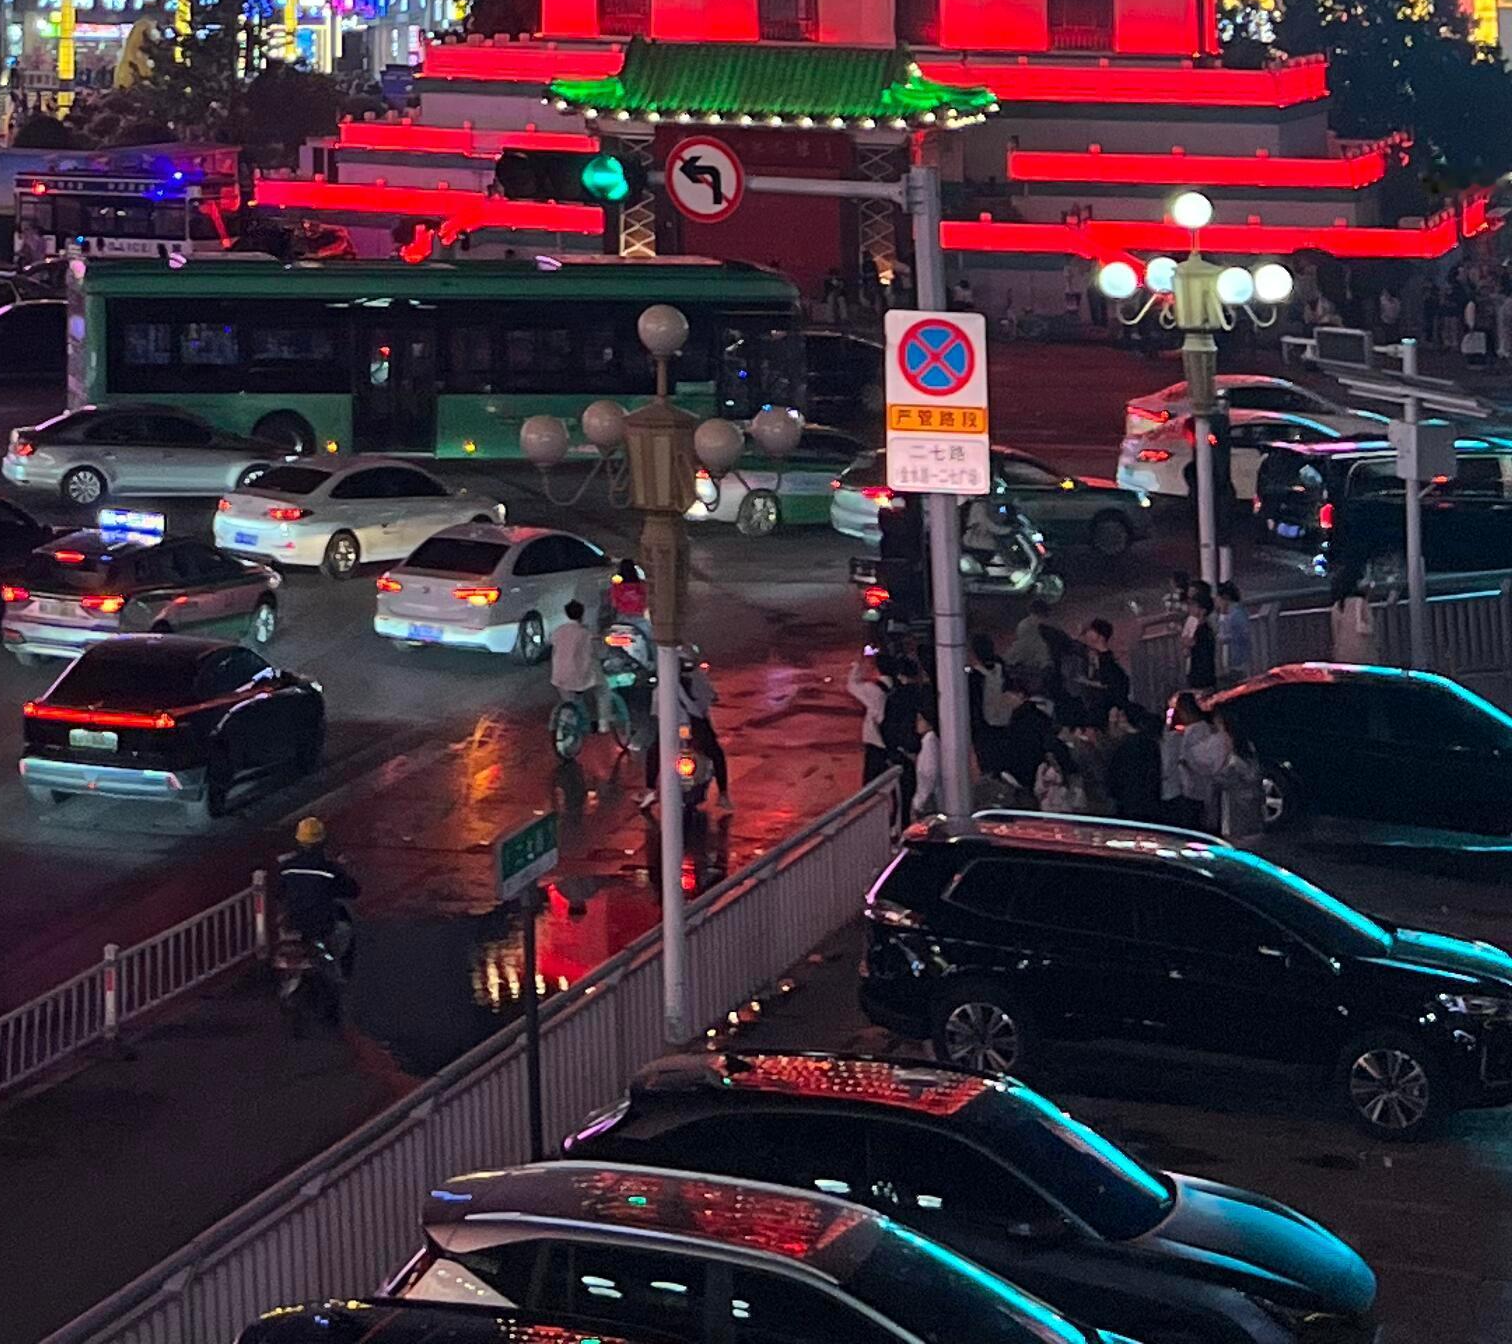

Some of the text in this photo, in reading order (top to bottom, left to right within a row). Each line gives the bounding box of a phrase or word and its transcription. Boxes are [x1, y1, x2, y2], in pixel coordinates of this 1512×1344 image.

[896, 409, 977, 428] 严管路段
[909, 444, 965, 462] 二七路
